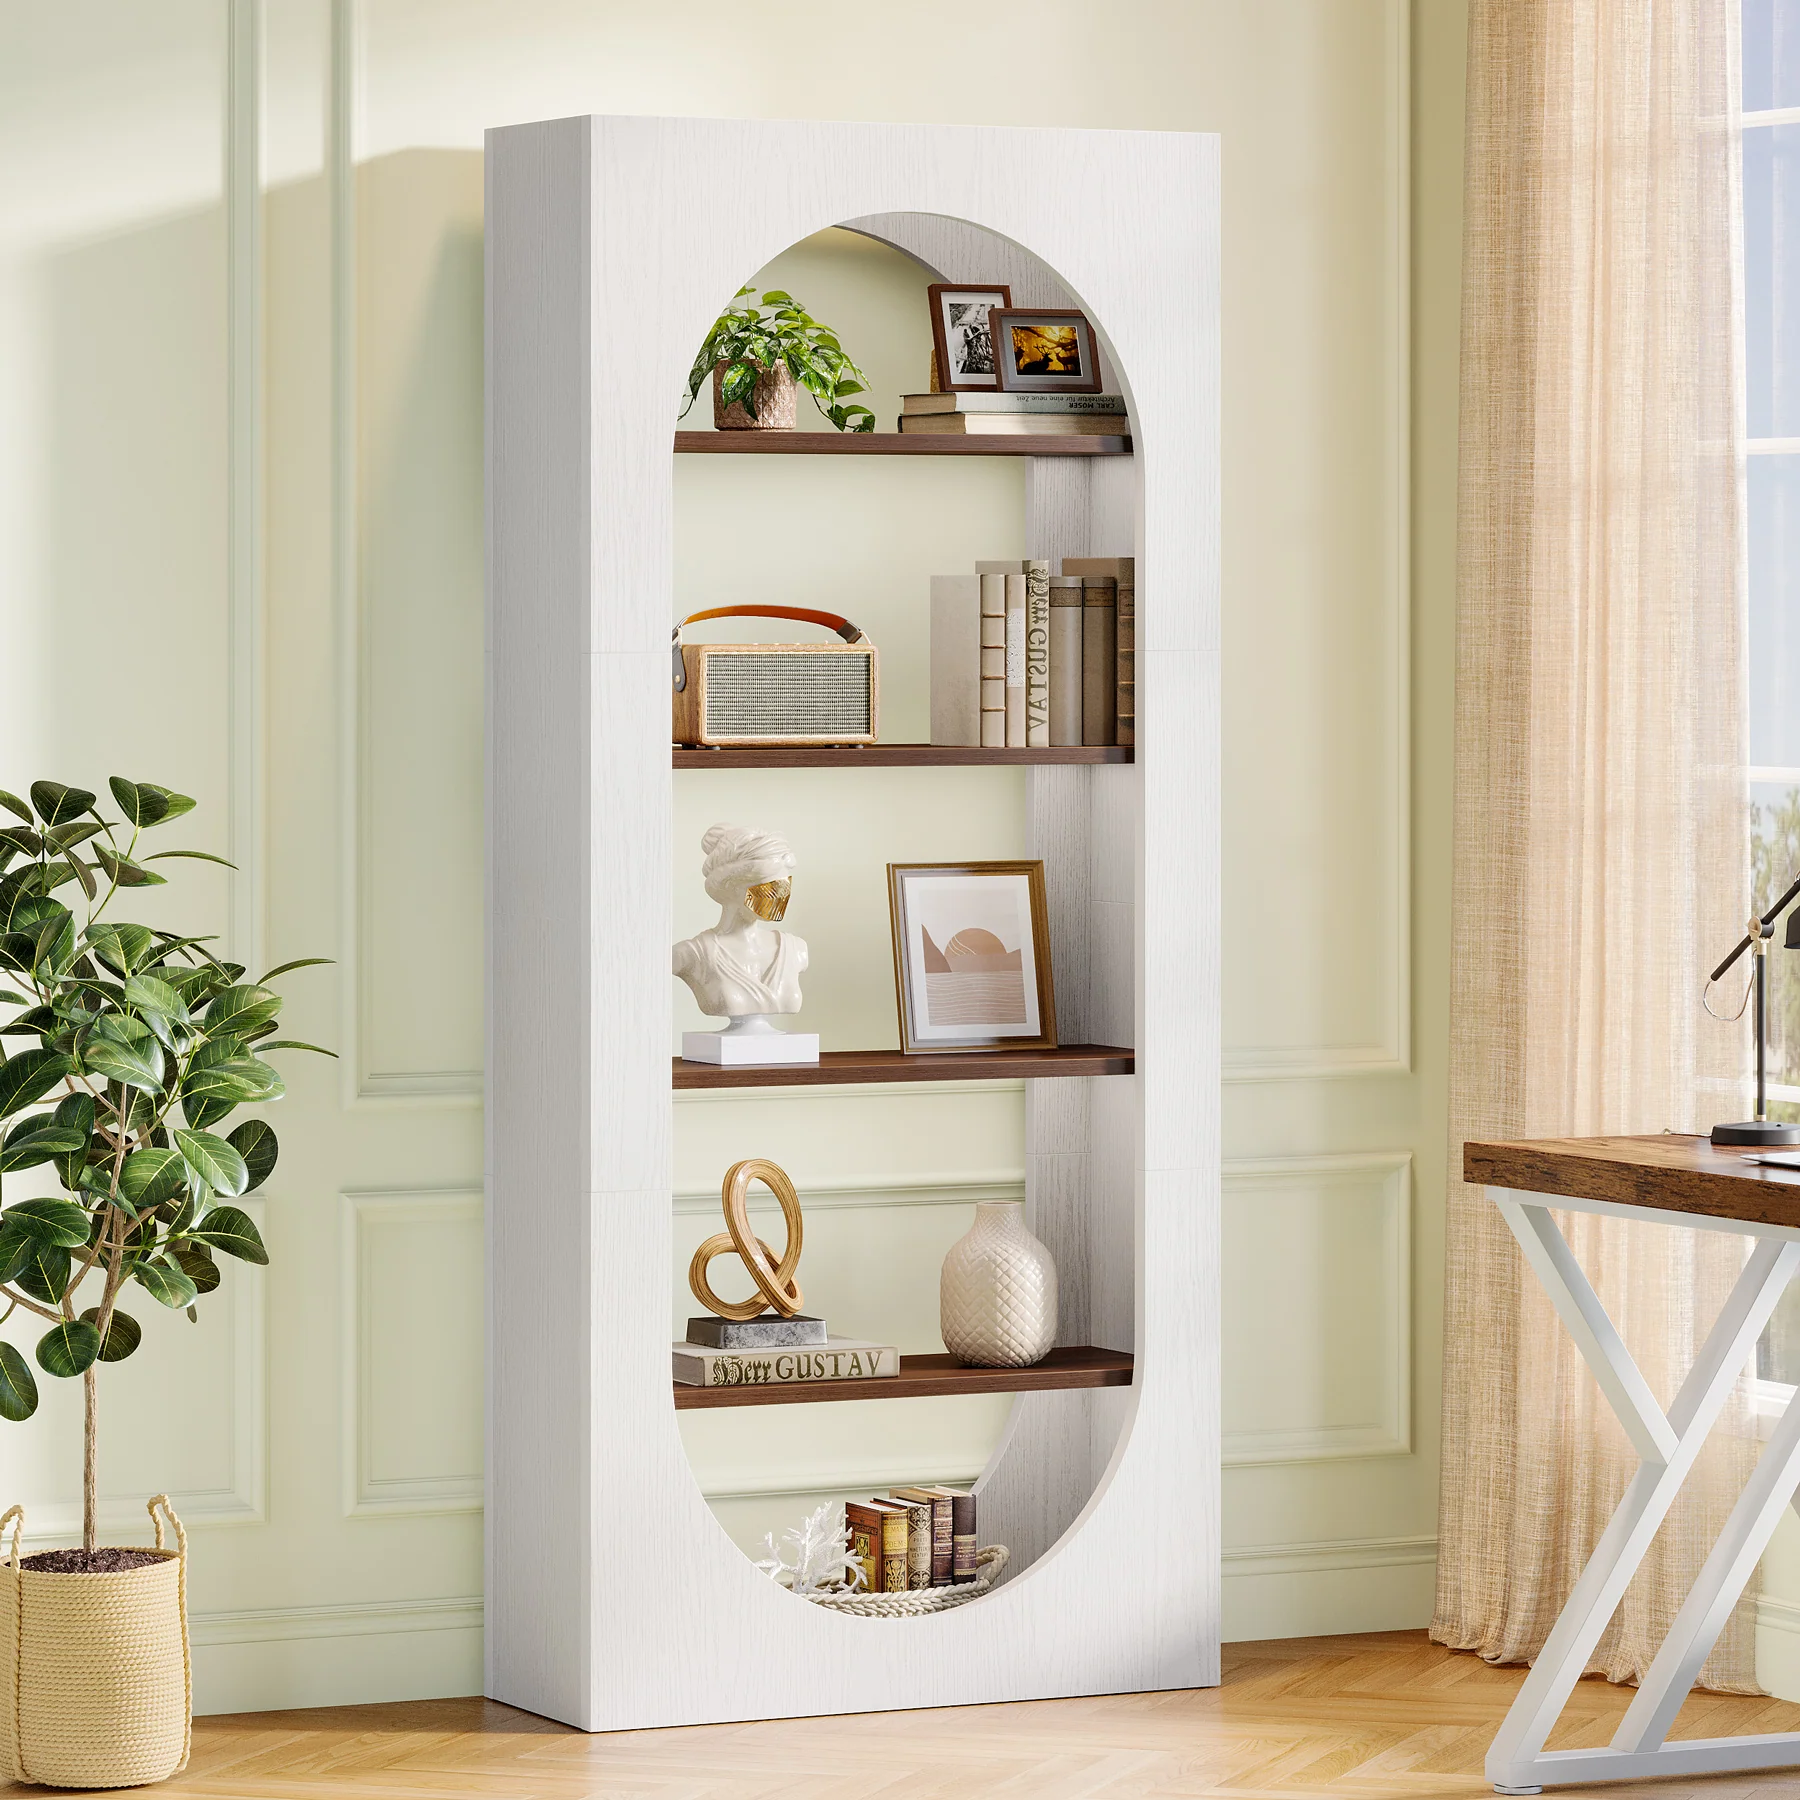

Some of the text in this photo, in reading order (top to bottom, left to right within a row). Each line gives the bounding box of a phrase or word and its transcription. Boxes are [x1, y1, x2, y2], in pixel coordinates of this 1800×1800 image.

[712, 1350, 884, 1385] Herr GUSTAV
[884, 1539, 907, 1549] POEMS
